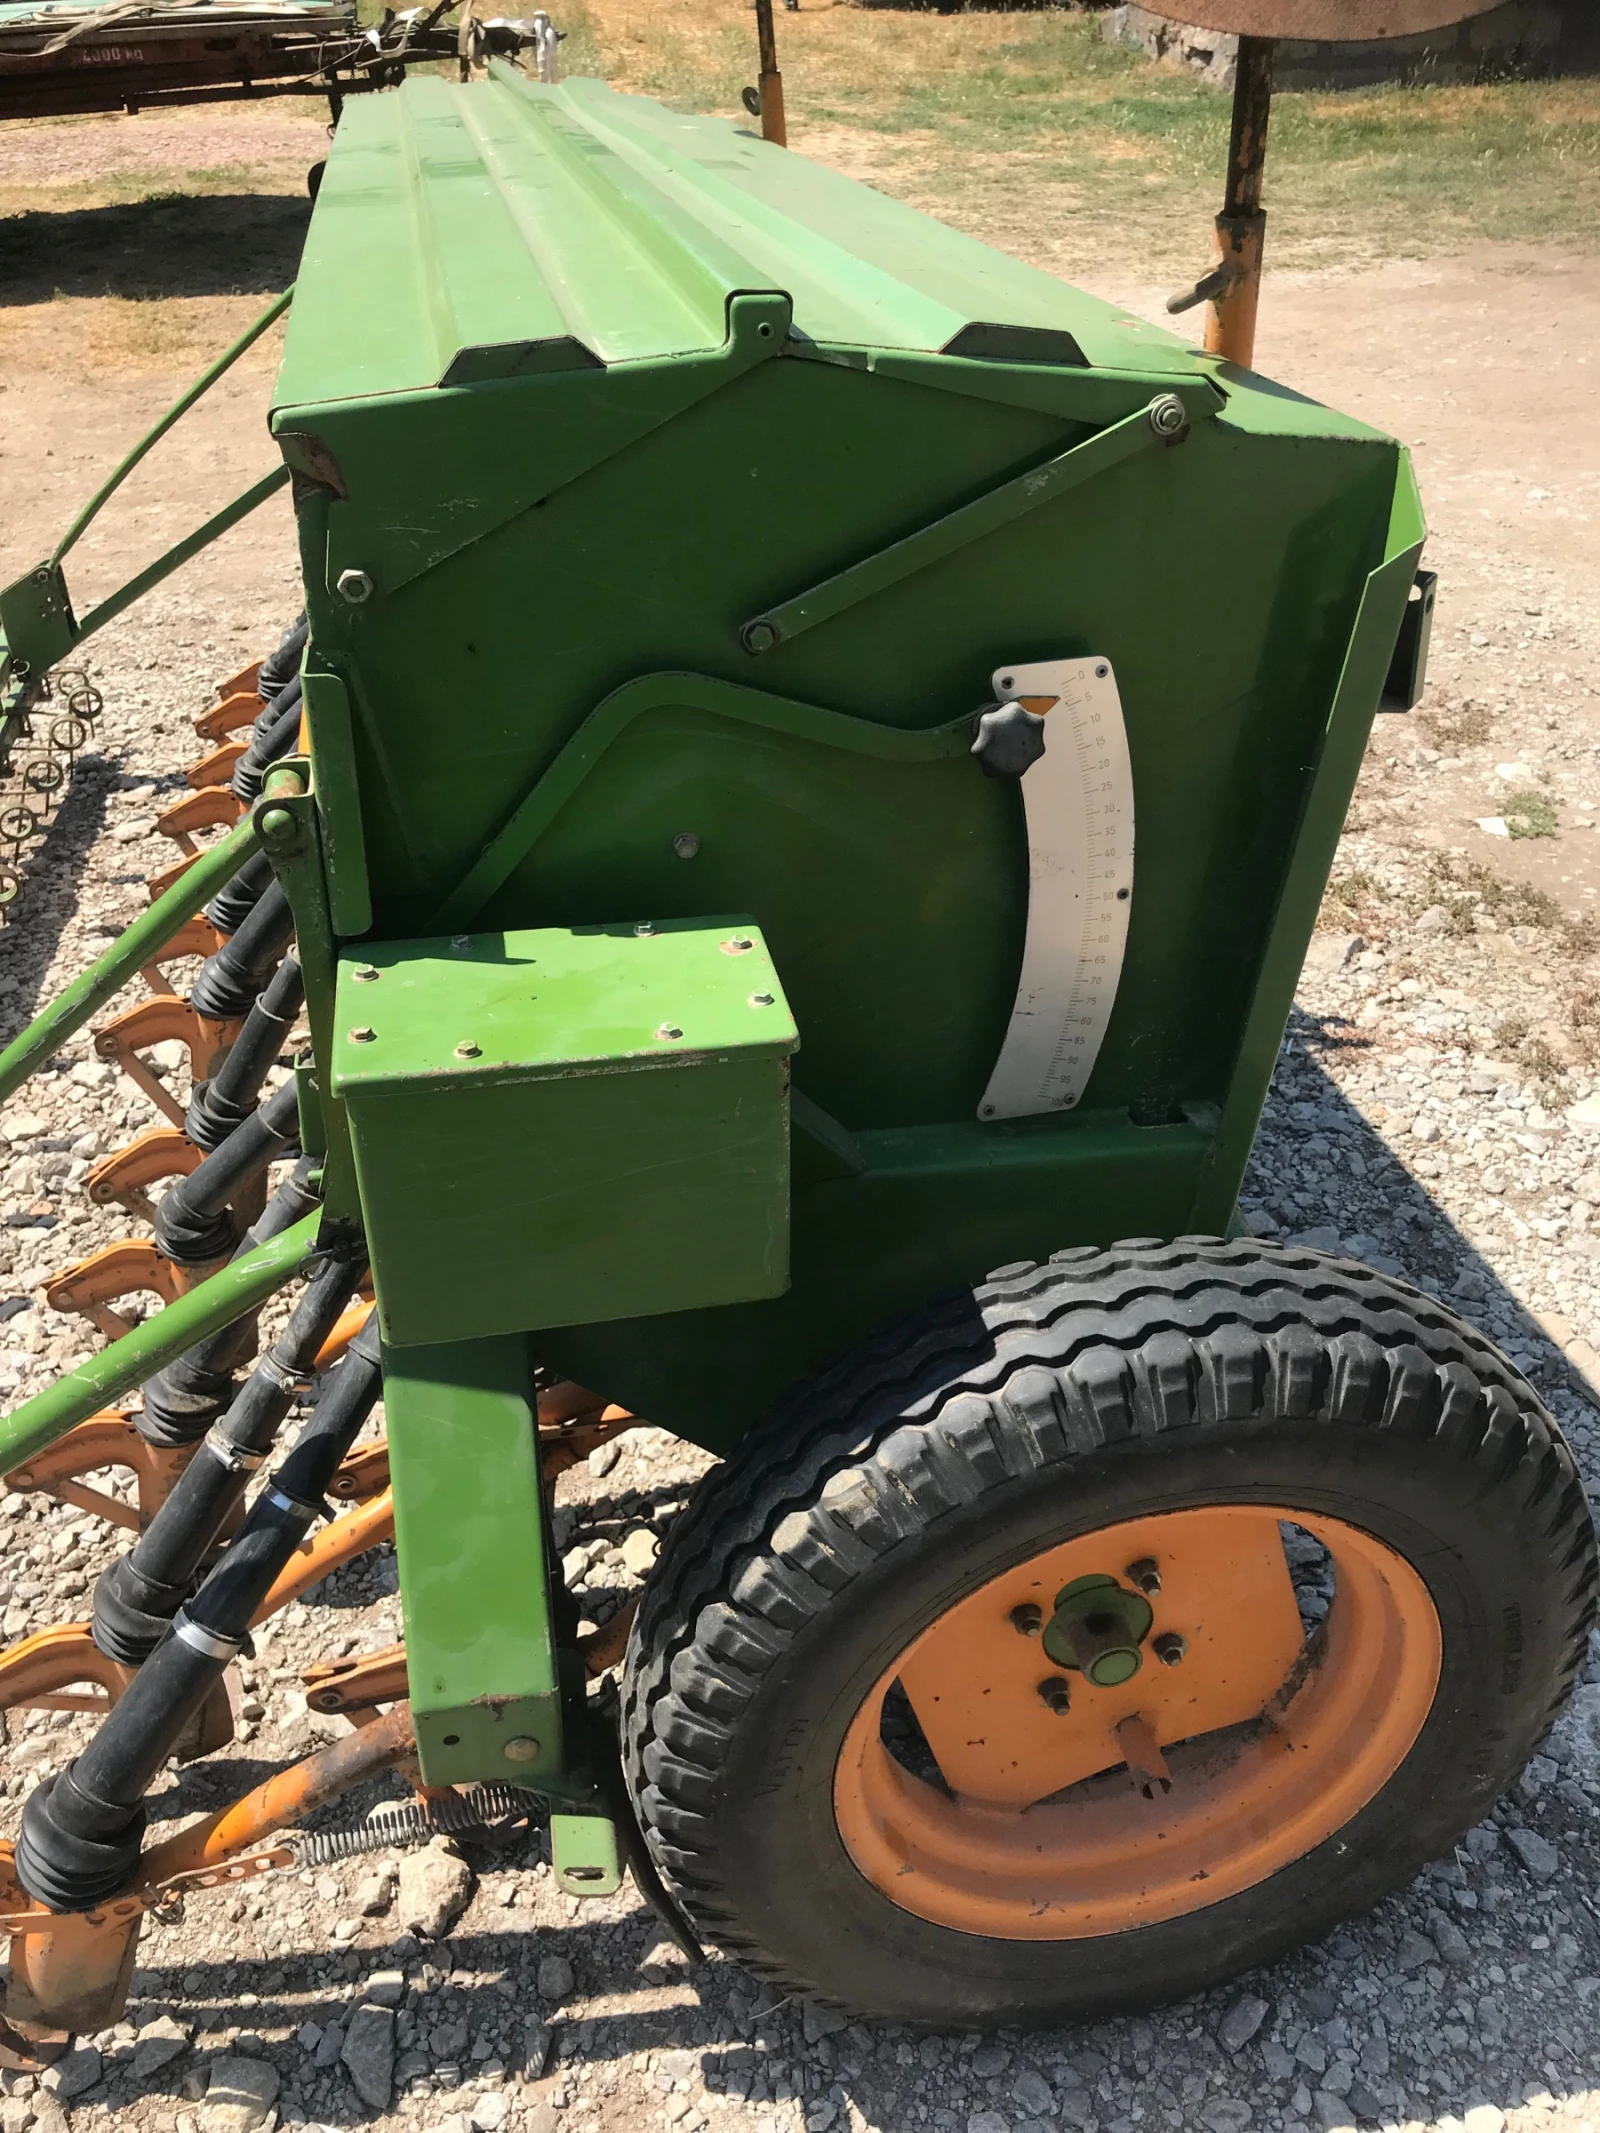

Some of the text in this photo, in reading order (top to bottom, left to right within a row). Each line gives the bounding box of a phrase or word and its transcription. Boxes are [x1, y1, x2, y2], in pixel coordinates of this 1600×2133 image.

[82, 47, 121, 62] 4000
[1078, 670, 1085, 680] 0
[1084, 692, 1092, 701] 5
[1090, 714, 1101, 723] 10
[1095, 736, 1106, 746] 15
[1098, 759, 1110, 768] 20
[1101, 781, 1113, 791] 25
[1103, 804, 1115, 814] 30
[1104, 826, 1116, 835] 35
[1104, 848, 1116, 857] 40
[1104, 870, 1115, 879] 45
[1103, 891, 1114, 901] 50
[1100, 913, 1112, 922] 55
[1098, 935, 1110, 943] 60
[1094, 956, 1106, 964] 65
[1090, 976, 1102, 985] 70
[1085, 997, 1097, 1006] 75
[1080, 1017, 1092, 1025] 80
[1074, 1036, 1085, 1045] 85
[1067, 1056, 1078, 1065] 90
[1060, 1075, 1071, 1084] 95
[1051, 1098, 1065, 1107] 100
